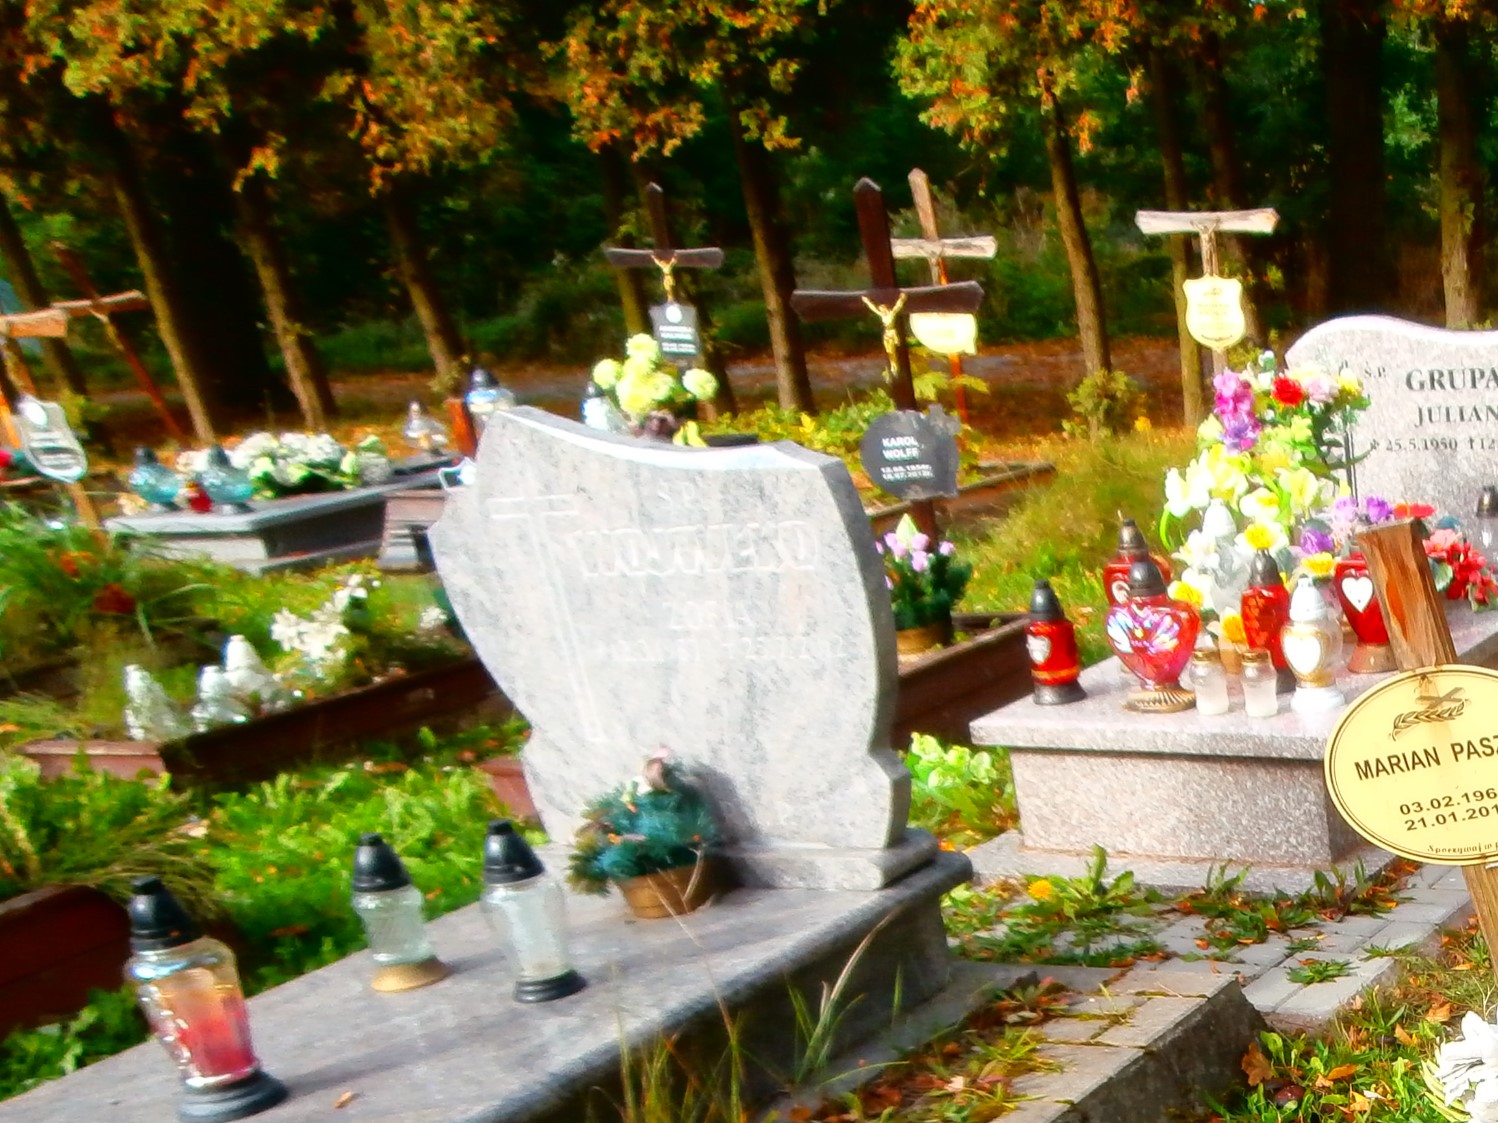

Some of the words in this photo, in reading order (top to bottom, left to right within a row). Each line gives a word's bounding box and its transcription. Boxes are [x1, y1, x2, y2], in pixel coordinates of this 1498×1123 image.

[882, 436, 920, 447] KAROL
[882, 447, 920, 460] WOLFF
[1354, 746, 1441, 781] MARIAN
